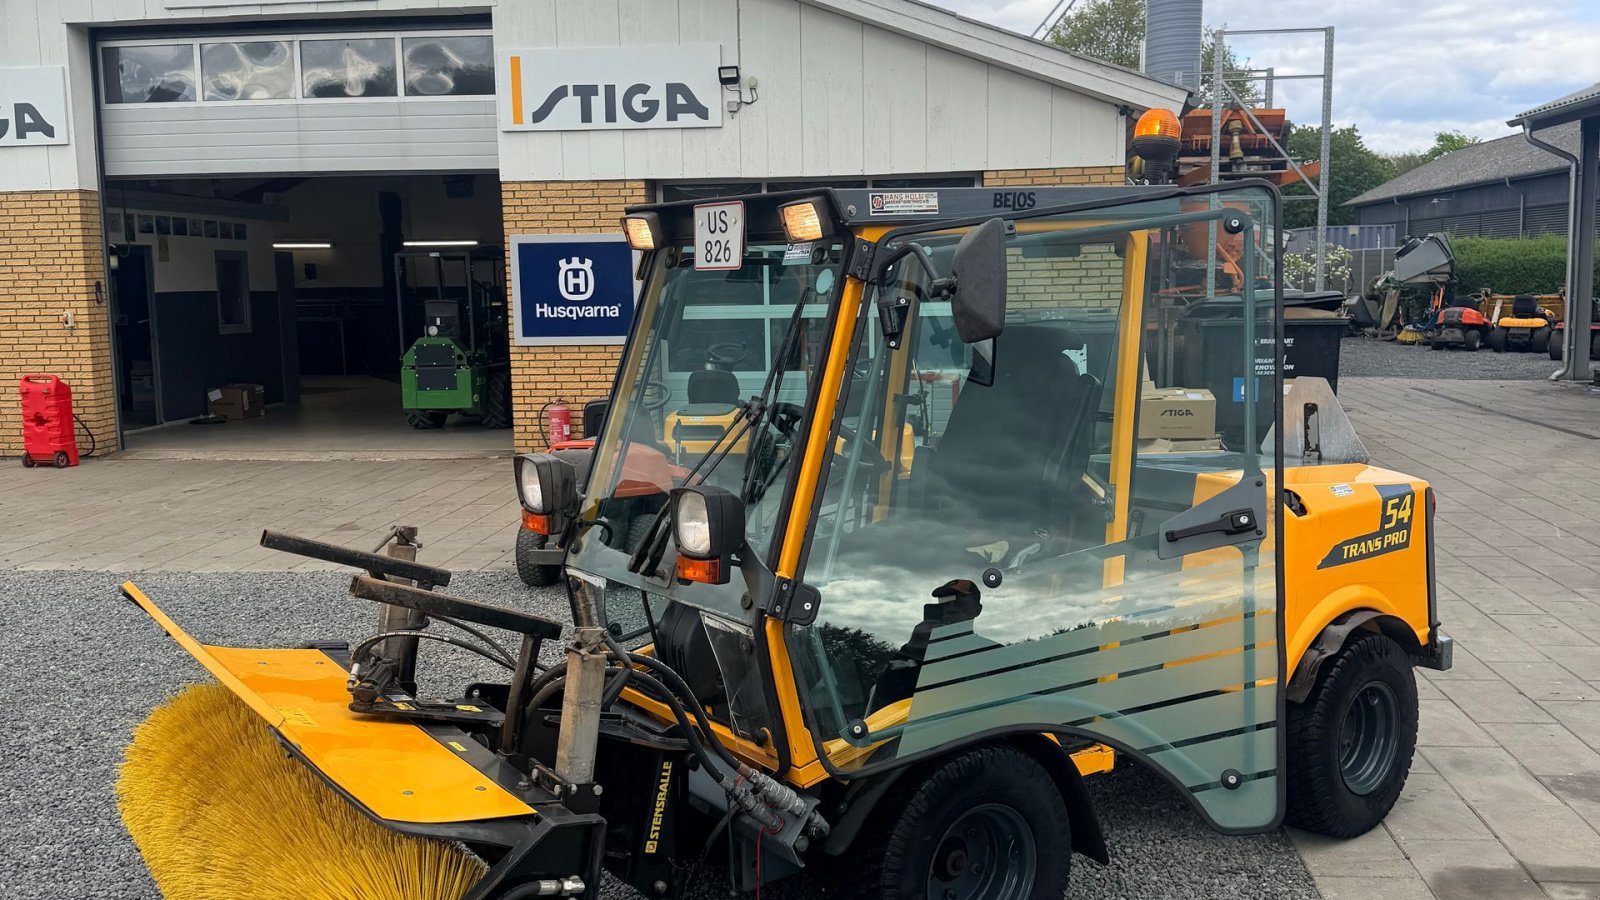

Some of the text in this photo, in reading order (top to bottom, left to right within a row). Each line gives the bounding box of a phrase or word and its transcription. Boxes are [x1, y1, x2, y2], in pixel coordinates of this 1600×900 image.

[532, 82, 709, 124] STIGA
[0, 103, 55, 139] A
[993, 191, 1036, 211] BELOS
[707, 210, 728, 234] US
[705, 239, 731, 263] 826
[535, 303, 621, 320] Husqvarna
[1160, 409, 1194, 417] STIGA
[1384, 494, 1412, 530] 54
[1342, 529, 1408, 559] TRANS PRO
[649, 761, 673, 840] STENSBALLE
